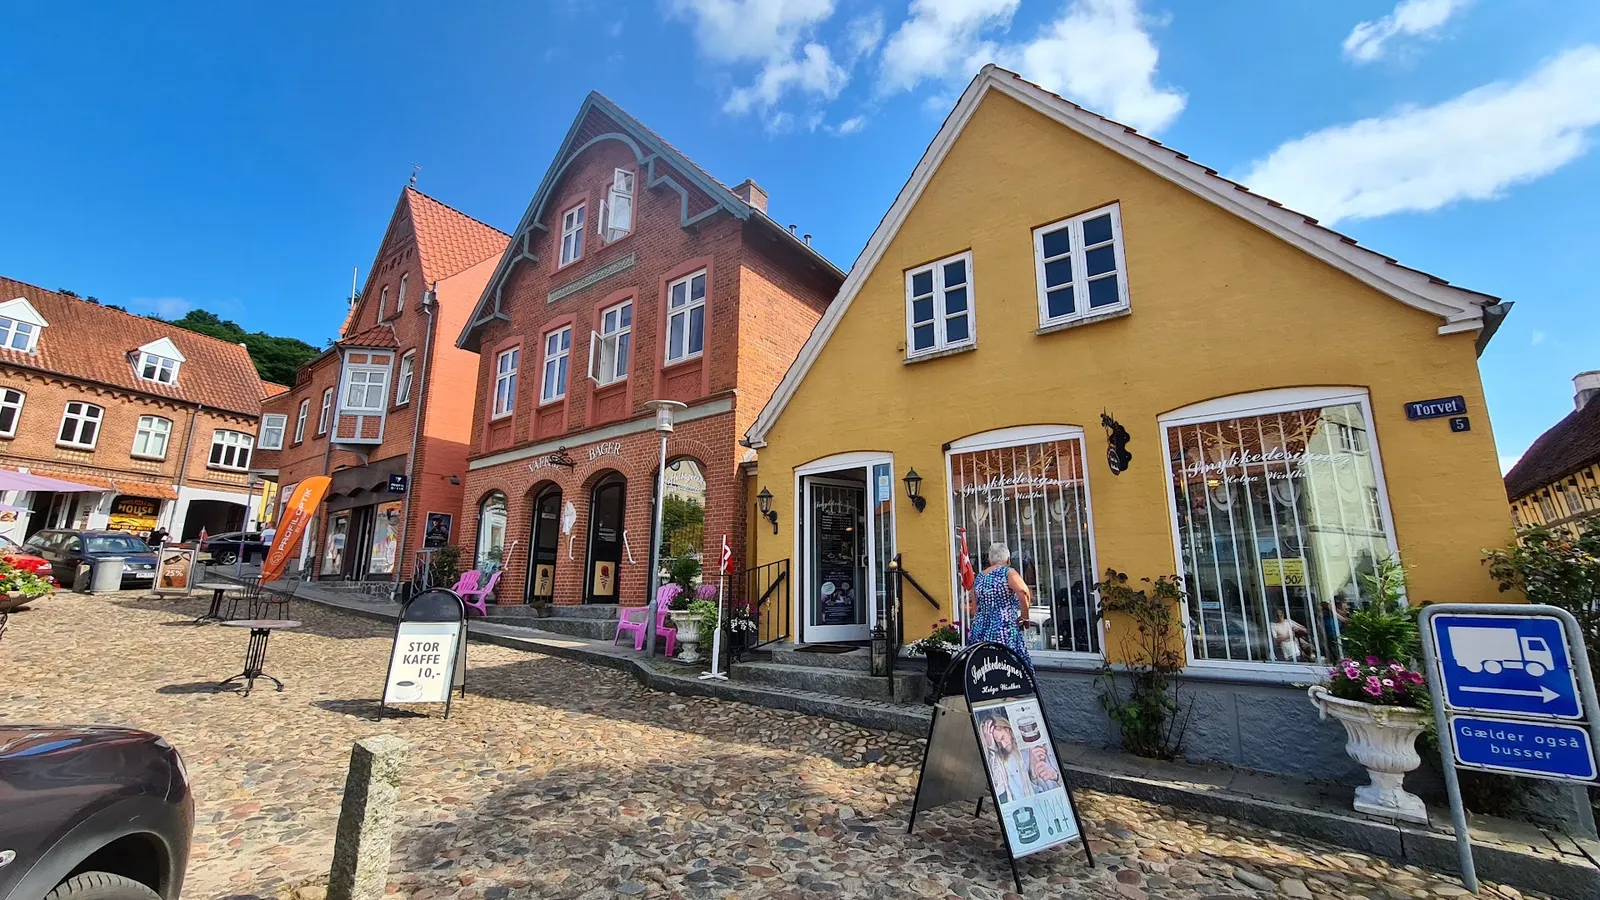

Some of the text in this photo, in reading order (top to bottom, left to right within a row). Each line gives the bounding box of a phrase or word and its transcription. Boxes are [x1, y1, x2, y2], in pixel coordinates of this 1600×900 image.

[1413, 400, 1457, 416] Torvet
[1455, 419, 1464, 430] 5
[589, 442, 621, 461] BAGER
[1188, 446, 1350, 478] Smykkedesigner
[961, 471, 1072, 498] Smykkedesigner
[1221, 469, 1308, 486] Helga Winthe
[1014, 491, 1044, 501] Winthe
[118, 504, 154, 515] HOUSE
[279, 488, 313, 551] PROFIL OPTIK
[165, 569, 184, 577] 25%
[1285, 575, 1303, 585] 50%
[408, 642, 440, 652] STOR
[403, 654, 440, 665] KAFFE
[418, 668, 441, 679] 10,-
[971, 656, 1023, 685] Smykkedesigner
[981, 682, 1021, 695] Helga Winther
[1461, 726, 1580, 748] Gælder også
[1490, 744, 1552, 759] busser
